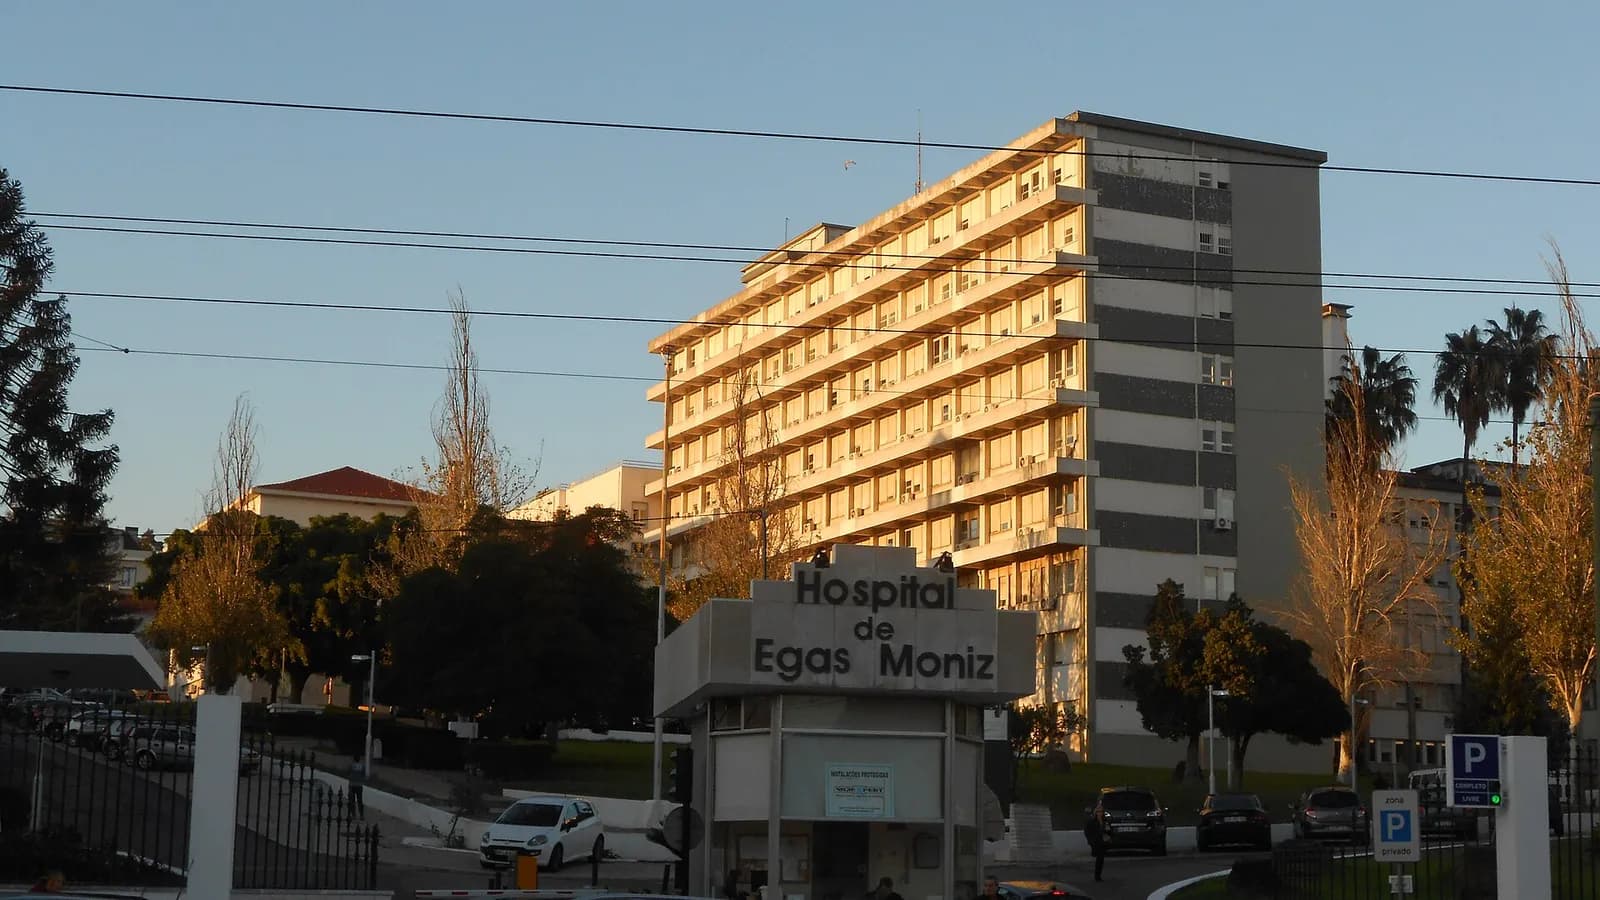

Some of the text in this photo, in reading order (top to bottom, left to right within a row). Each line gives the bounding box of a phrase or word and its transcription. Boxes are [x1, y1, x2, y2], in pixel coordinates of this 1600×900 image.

[797, 570, 955, 613] Hospital
[854, 616, 895, 641] de
[755, 638, 994, 682] Egas Moniz
[1464, 742, 1486, 773] P
[1387, 813, 1405, 840] P
[1382, 847, 1412, 856] privado
